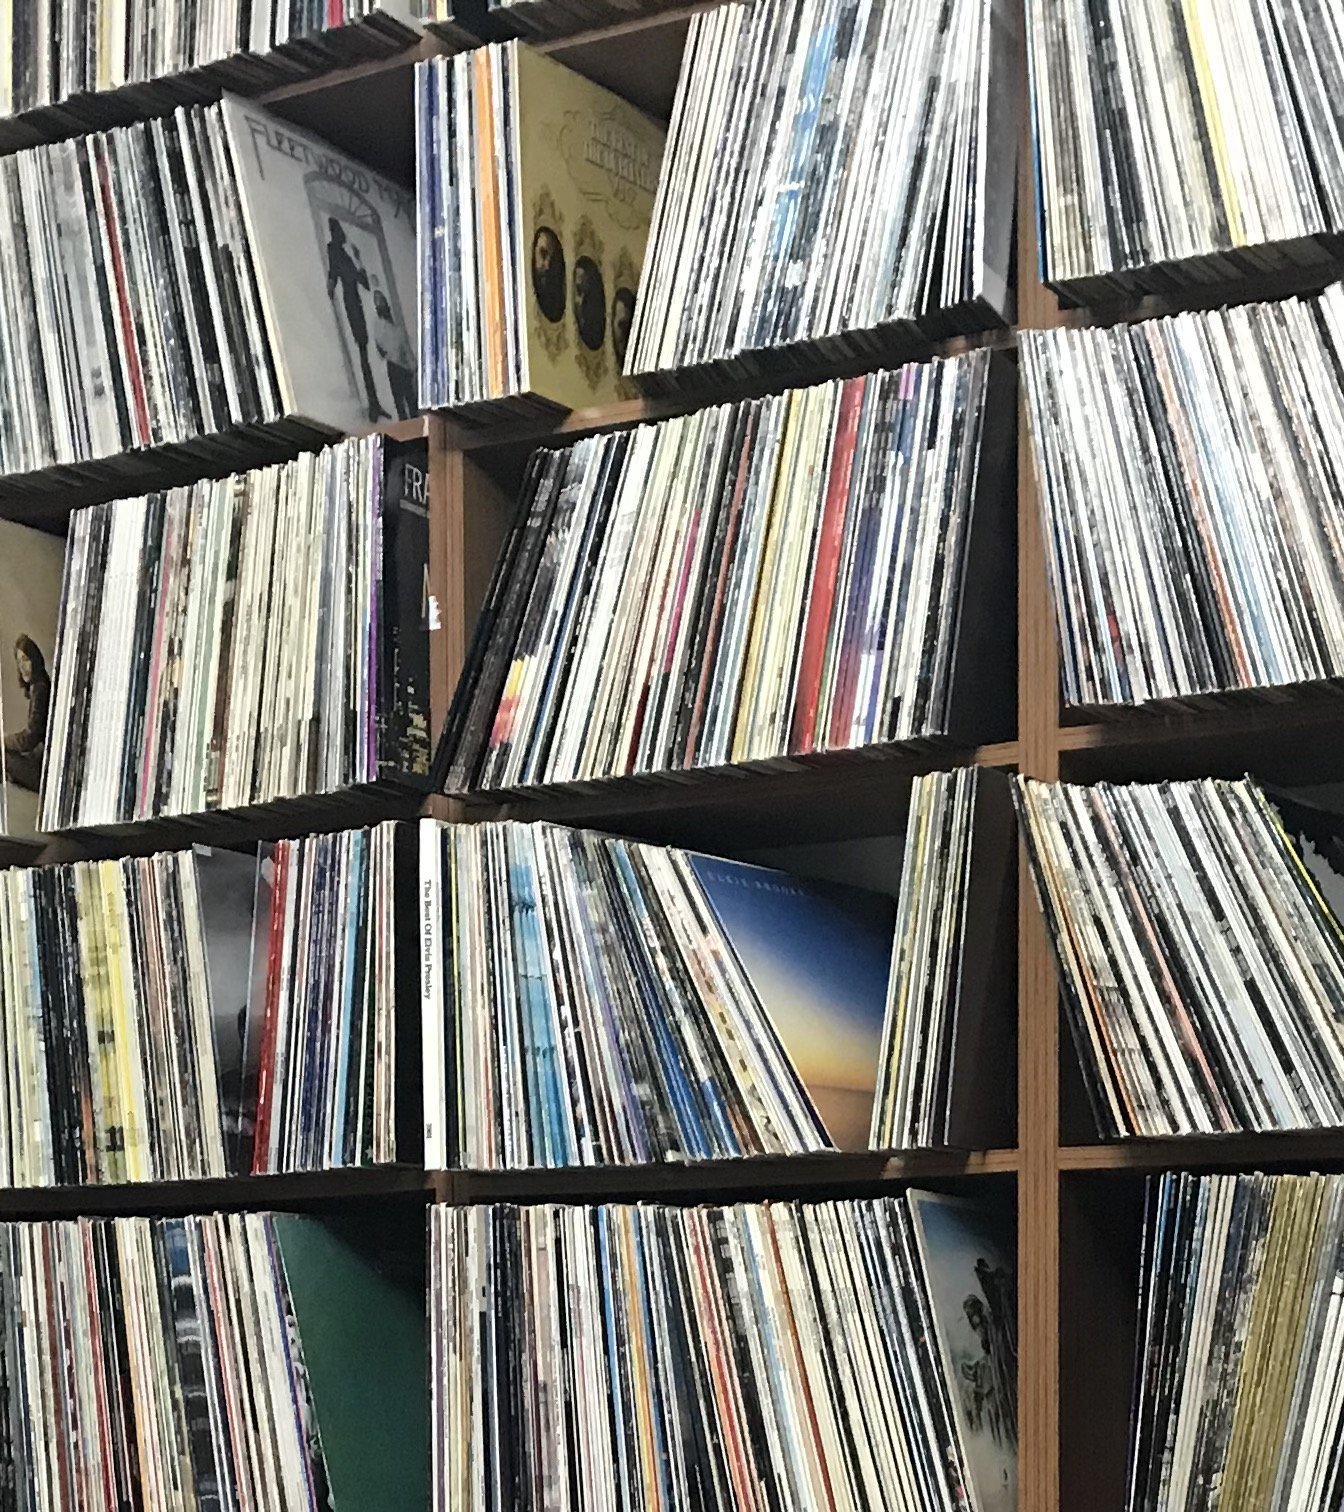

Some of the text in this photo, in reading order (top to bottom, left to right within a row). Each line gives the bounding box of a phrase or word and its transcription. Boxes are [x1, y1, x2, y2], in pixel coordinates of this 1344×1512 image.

[423, 880, 432, 898] The
[423, 900, 432, 921] Best
[424, 923, 433, 936] Of
[424, 963, 433, 1000] Presley
